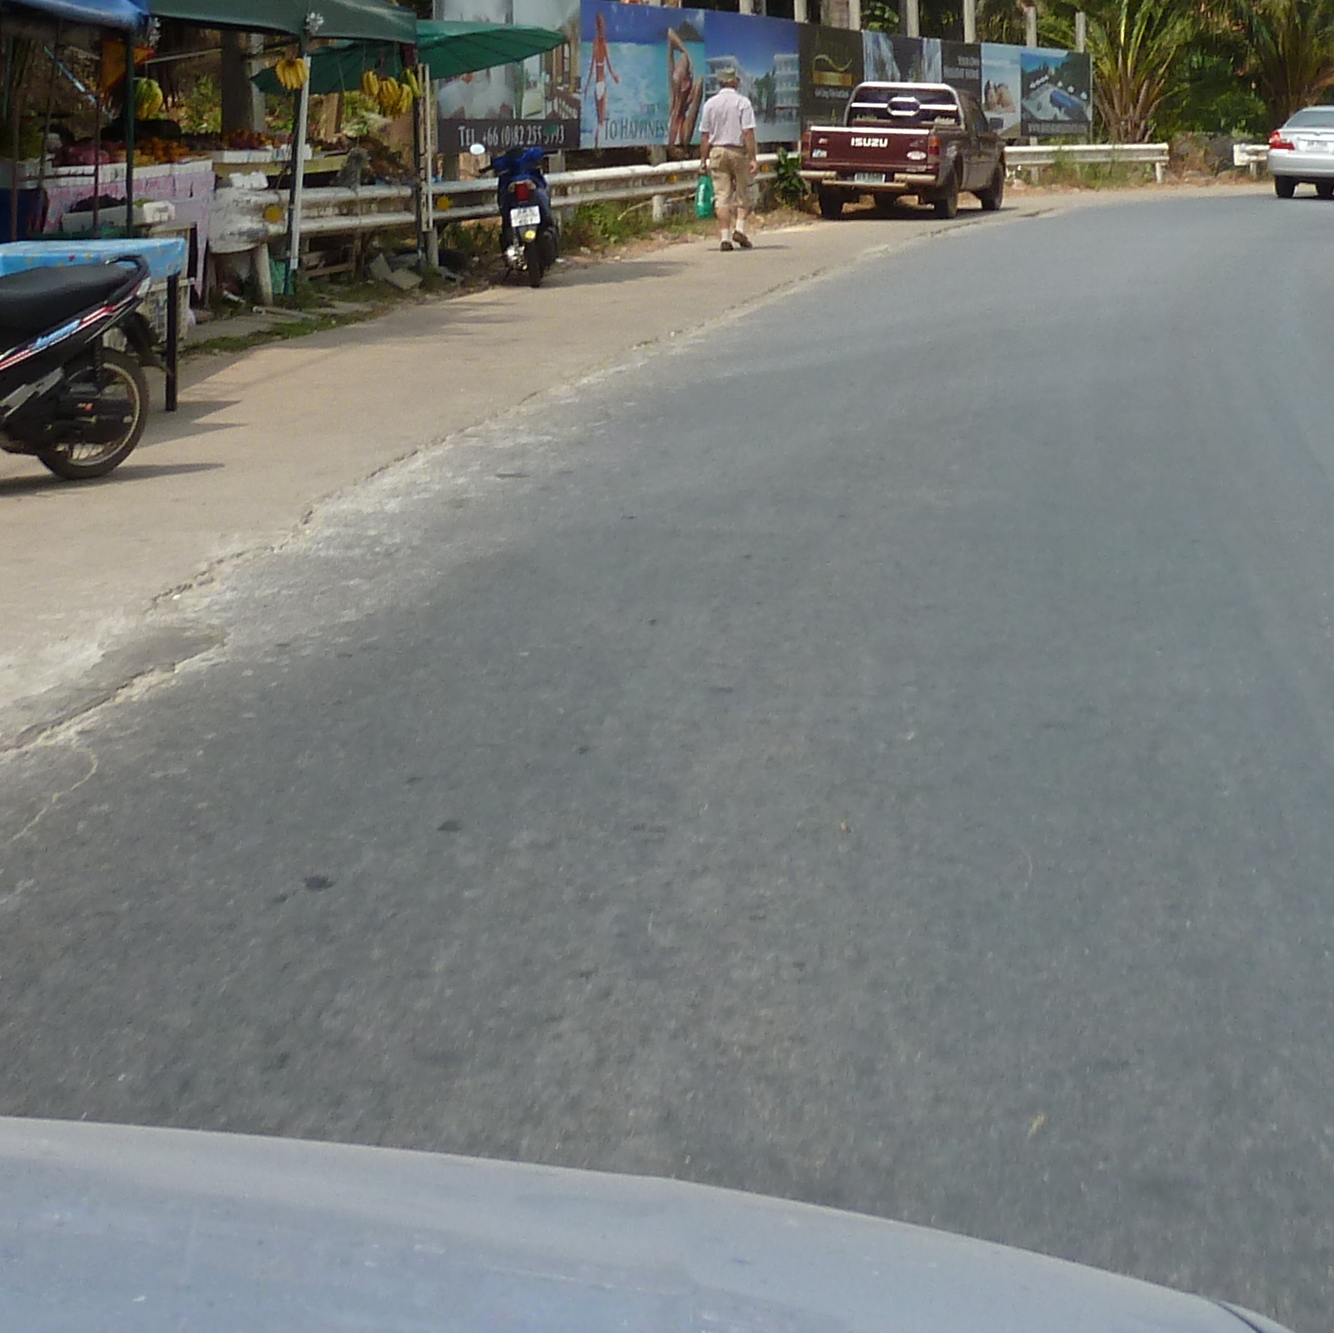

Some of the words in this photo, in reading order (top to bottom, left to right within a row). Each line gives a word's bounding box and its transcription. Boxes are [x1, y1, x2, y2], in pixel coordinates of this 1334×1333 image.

[482, 127, 498, 146] +66
[605, 117, 617, 140] TO
[851, 137, 888, 147] ISUZU
